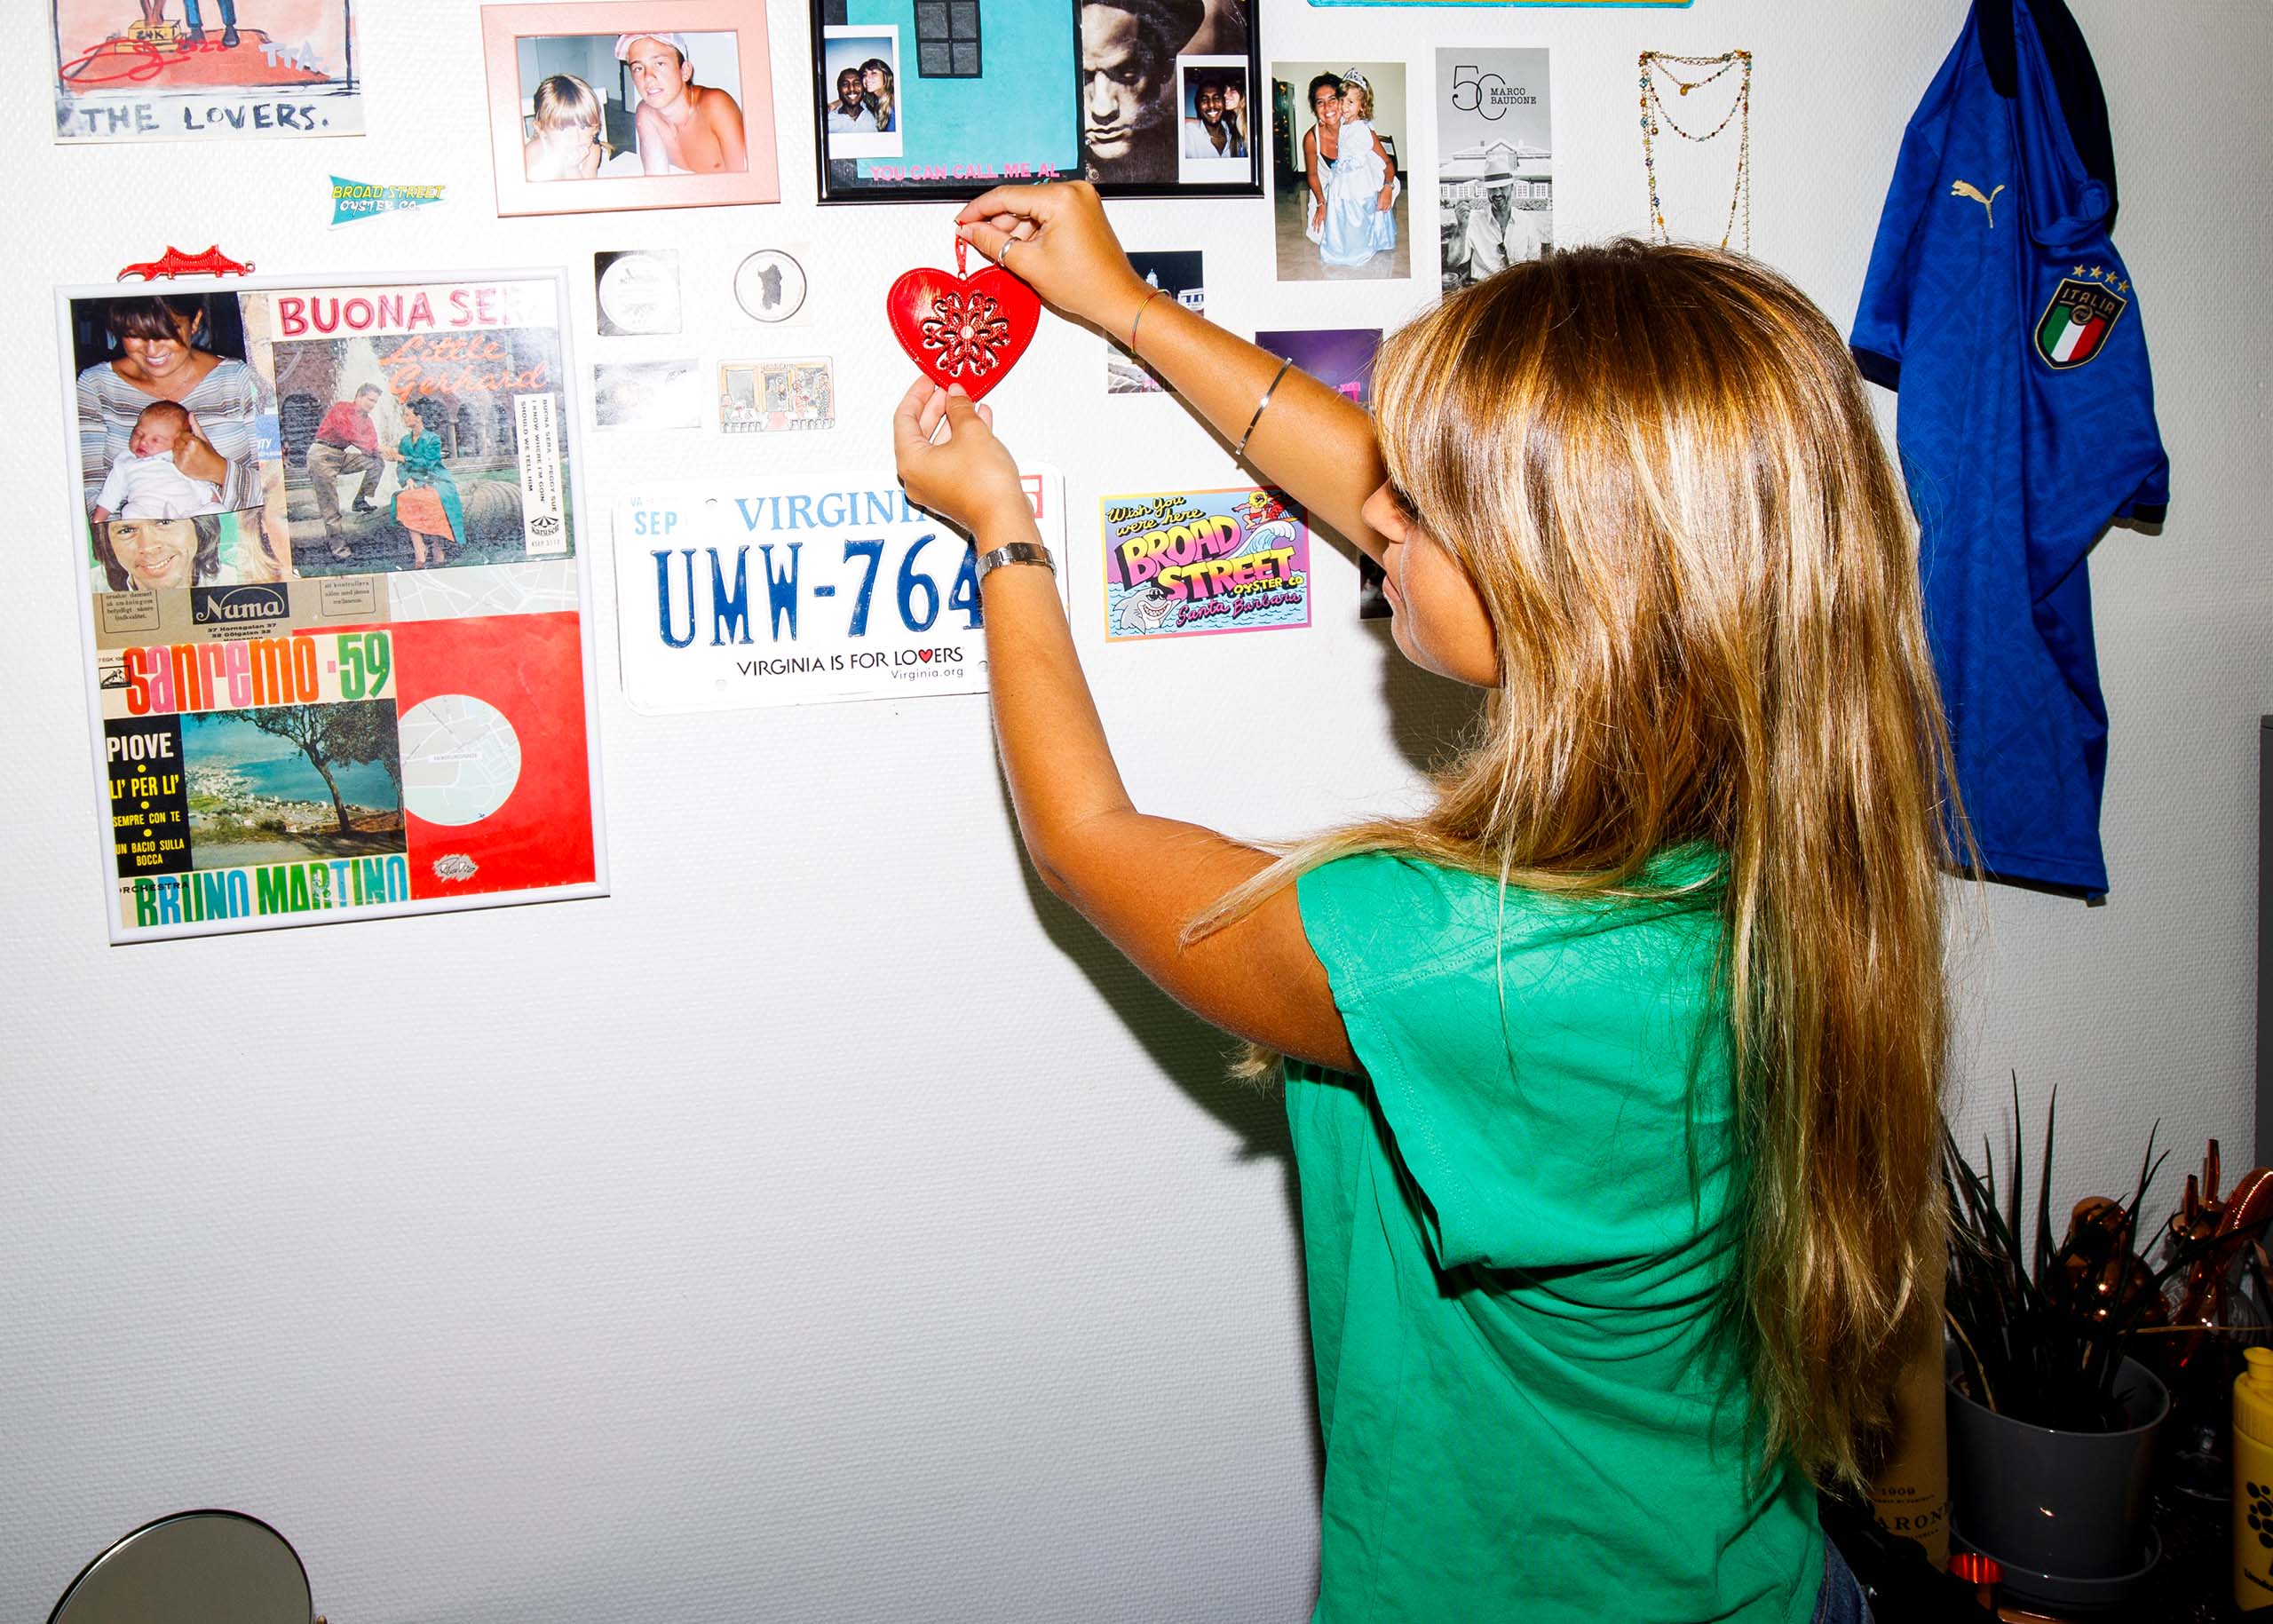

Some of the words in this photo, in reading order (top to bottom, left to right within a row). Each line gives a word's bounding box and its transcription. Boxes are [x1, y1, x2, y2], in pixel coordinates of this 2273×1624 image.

[80, 104, 159, 133] THE
[870, 165, 905, 182] YOU
[910, 164, 947, 181] CAN
[952, 163, 999, 179] CALL
[1003, 162, 1032, 178] ME
[1037, 162, 1060, 178] AL
[332, 185, 384, 199] BROAD
[388, 185, 445, 199] STREET
[339, 200, 395, 216] OYSTER
[278, 291, 435, 337] BUONA
[2062, 288, 2115, 314] ITALIA
[377, 334, 507, 367] Little
[390, 360, 549, 404] Gerhard
[520, 401, 529, 435] SHOULD
[524, 437, 530, 450] WE
[634, 511, 677, 535] SEP
[735, 489, 927, 532] VIRGINI
[1107, 505, 1152, 524] Wish
[1152, 496, 1186, 519] You
[1116, 518, 1160, 536] were
[1161, 508, 1205, 526] here
[1116, 515, 1242, 590] BROAD
[1156, 546, 1296, 603] STREET
[1234, 577, 1284, 596] OYSTER
[196, 587, 284, 622] Numa
[650, 534, 984, 649] UMW-764
[1176, 600, 1231, 627] Santa
[1232, 592, 1302, 620] Barbara
[737, 656, 825, 677] VIRGINIA
[831, 654, 844, 670] IS
[851, 652, 889, 669] FOR
[891, 667, 964, 682] Virginia.org
[106, 733, 174, 762] PIOVE
[131, 776, 158, 797] PER
[113, 813, 145, 828] SEMPRE
[148, 812, 166, 824] CON
[170, 811, 181, 822] TE
[115, 843, 127, 854] UN
[131, 841, 155, 852] BACIO
[160, 837, 185, 851] SULLA
[136, 853, 163, 867] BOCCA
[134, 869, 250, 927] BRUNO
[256, 855, 408, 915] MARTINO
